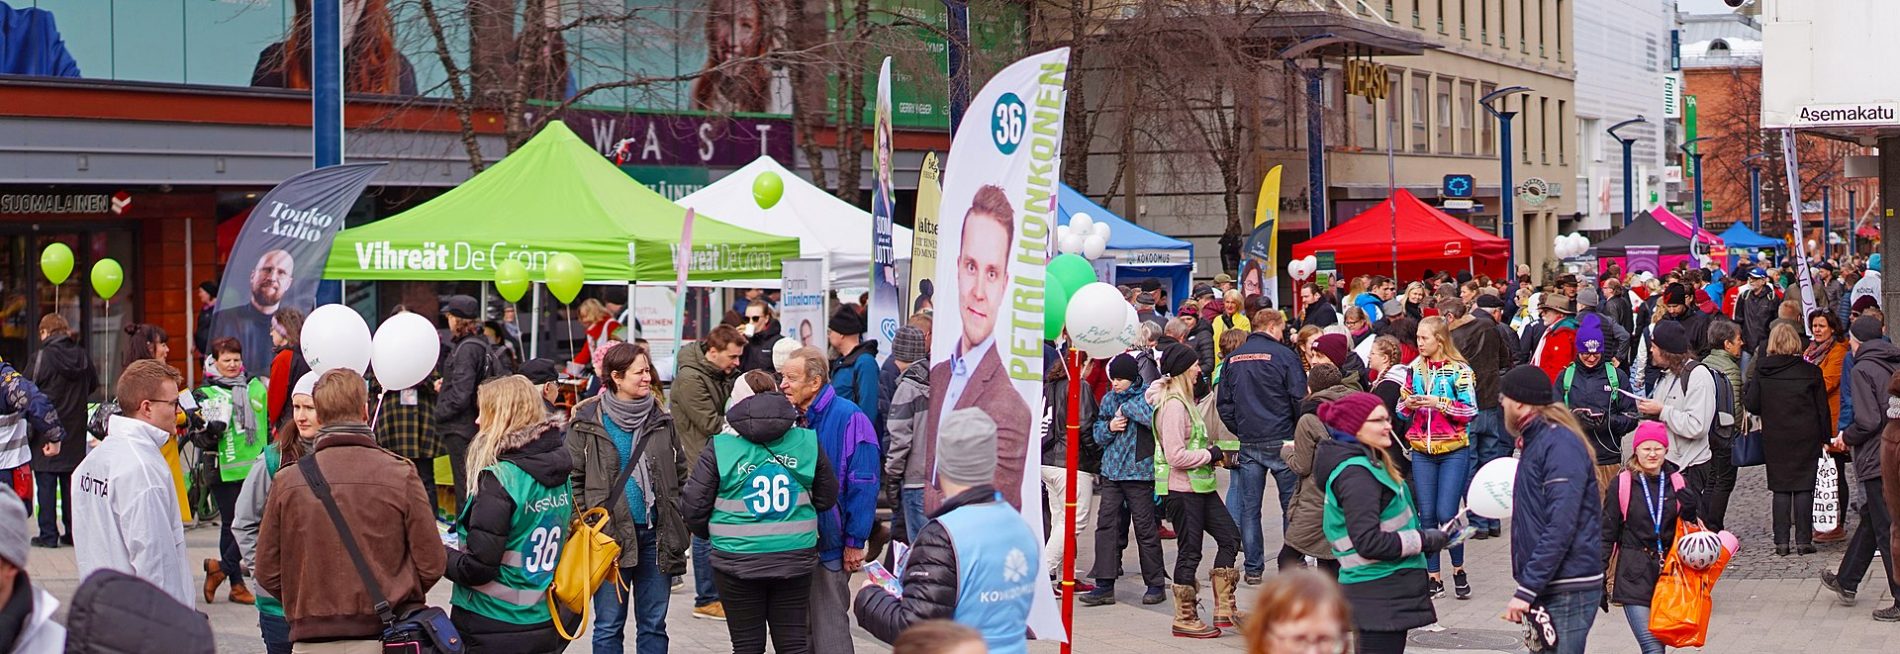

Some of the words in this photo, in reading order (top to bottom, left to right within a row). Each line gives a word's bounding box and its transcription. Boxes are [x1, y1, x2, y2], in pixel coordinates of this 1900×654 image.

[1347, 60, 1390, 104] VERSO
[1664, 76, 1676, 114] Fennia
[996, 102, 1022, 145] 36
[1800, 105, 1894, 121] Asemakatu
[1017, 62, 1067, 267] HONKONEN
[1, 194, 109, 213] SUOMALAINEN
[270, 201, 333, 227] Touko
[355, 241, 448, 271] Vihreät
[454, 242, 485, 271] De
[721, 244, 736, 270] De
[738, 244, 772, 271] Gröna
[1137, 253, 1170, 263] KOKOOMUS
[1010, 278, 1045, 382] PETRI
[752, 474, 790, 514] 36
[525, 526, 561, 573] 36
